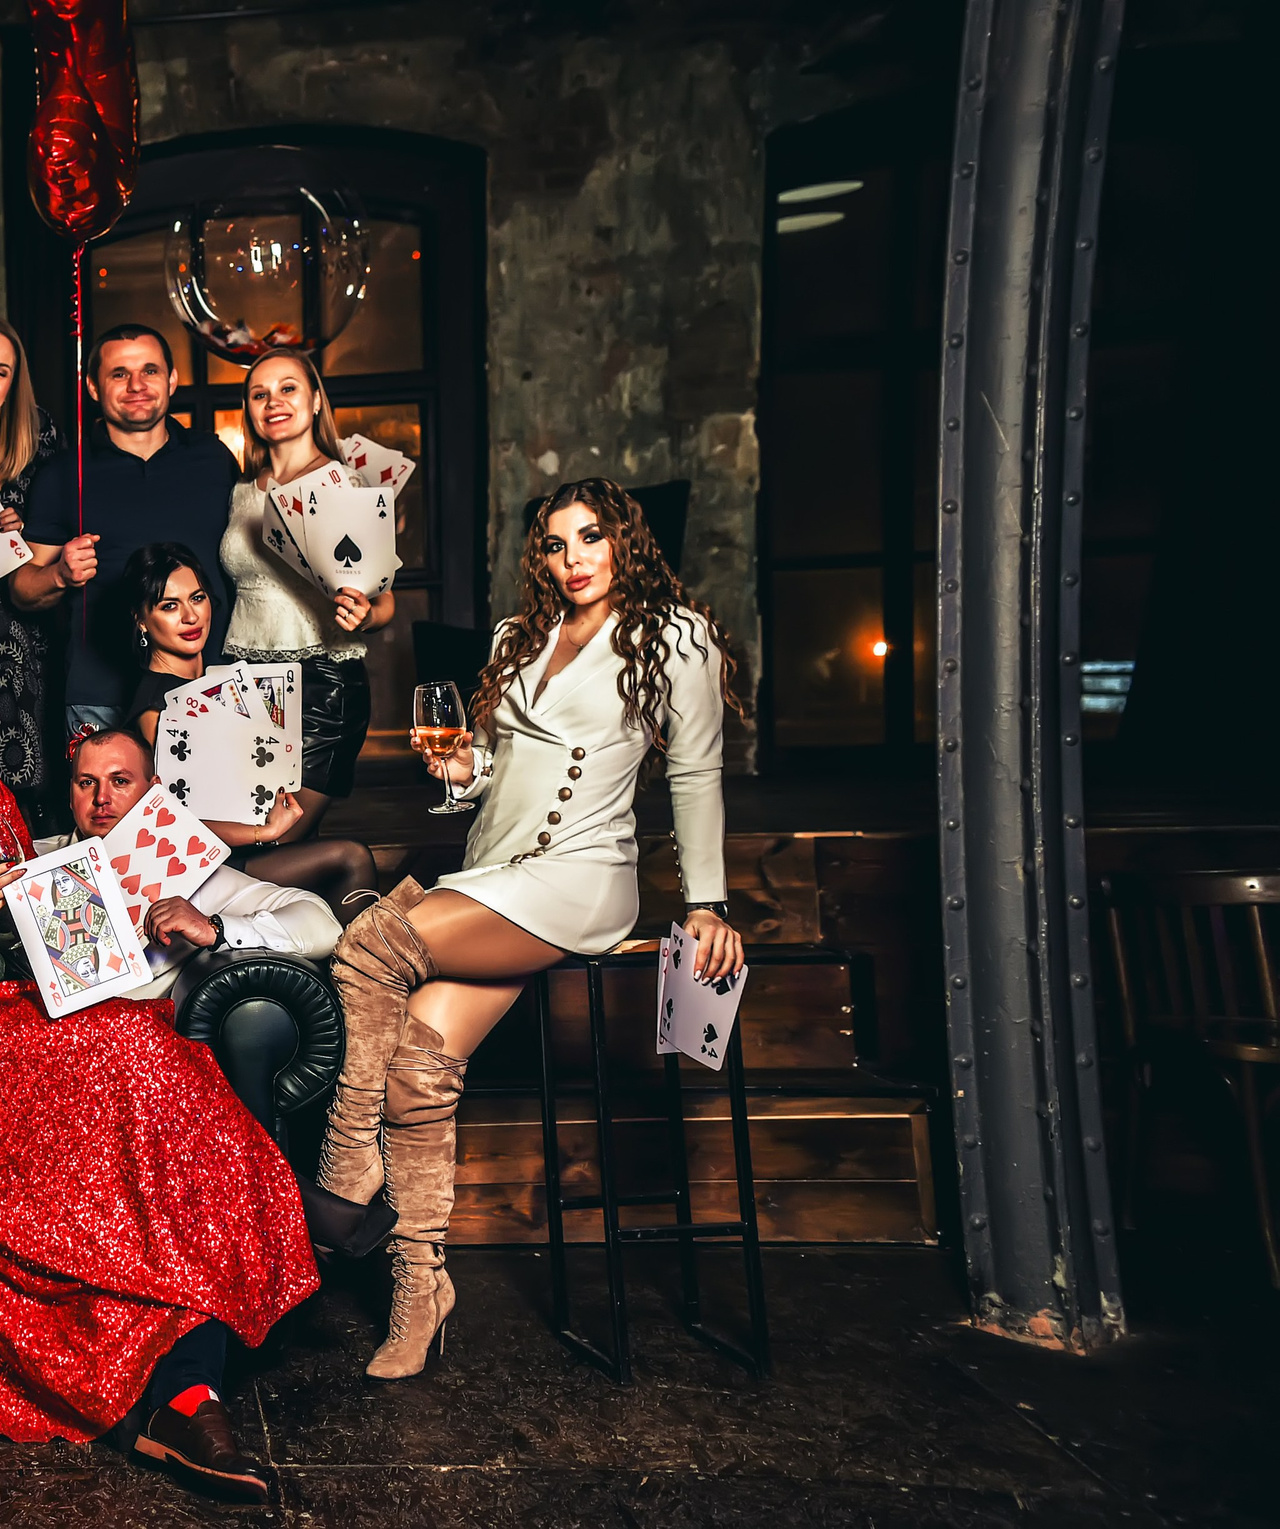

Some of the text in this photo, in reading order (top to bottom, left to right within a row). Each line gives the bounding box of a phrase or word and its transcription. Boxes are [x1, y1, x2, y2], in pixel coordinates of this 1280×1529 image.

[352, 441, 361, 453] 7
[328, 469, 341, 485] 10
[397, 464, 408, 477] 7
[277, 494, 289, 509] 10
[309, 491, 318, 505] A
[376, 494, 387, 508] A
[15, 547, 26, 560] 3
[235, 669, 244, 683] J
[287, 669, 295, 683] Q
[186, 697, 198, 708] 8
[166, 729, 179, 738] 4
[266, 736, 280, 745] 4
[149, 793, 165, 809] 10
[88, 846, 99, 861] Q
[205, 845, 221, 861] 10
[131, 962, 142, 977] Q
[52, 992, 63, 1007] Q
[707, 1047, 718, 1059] 4
